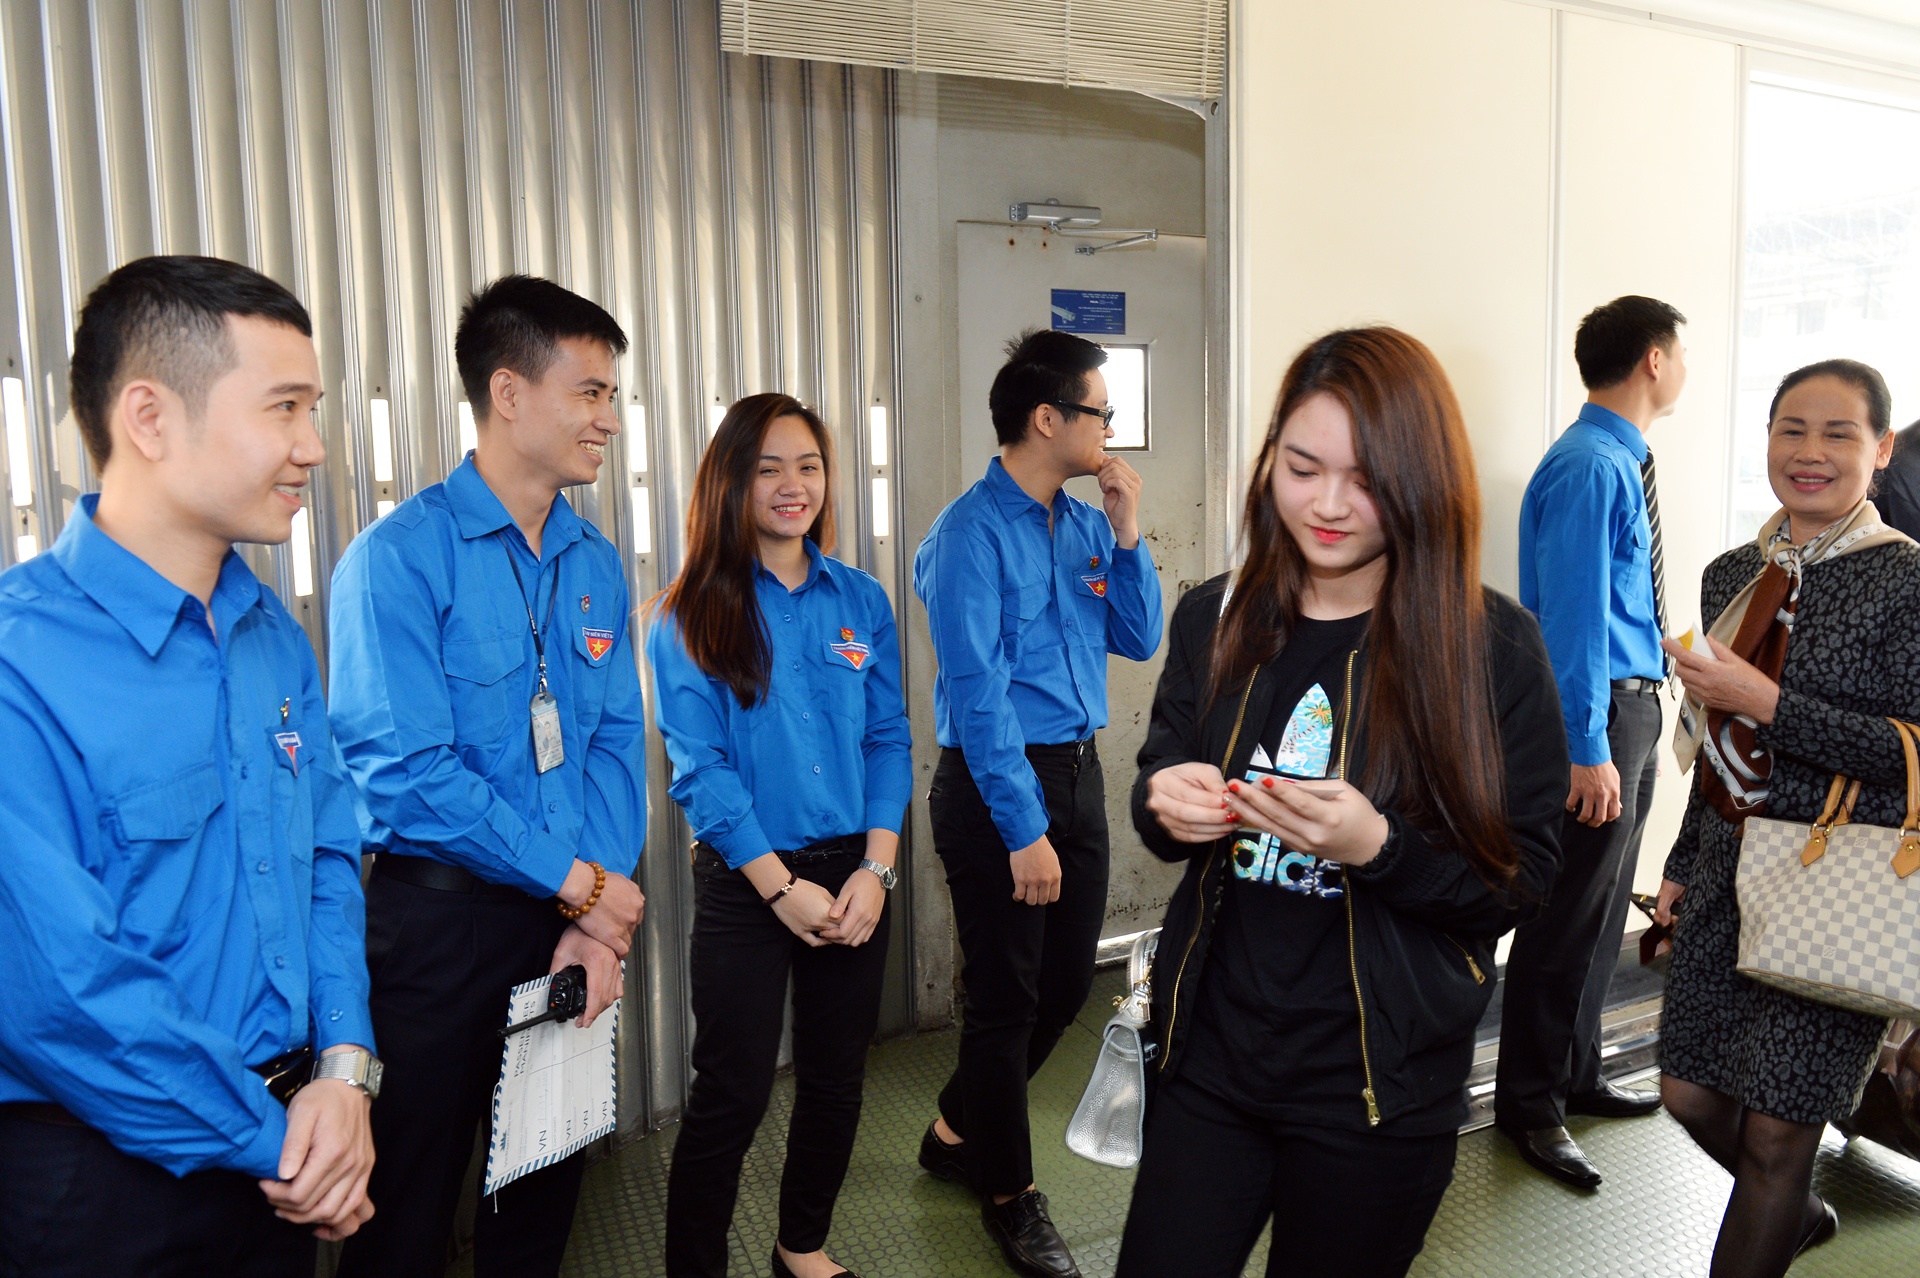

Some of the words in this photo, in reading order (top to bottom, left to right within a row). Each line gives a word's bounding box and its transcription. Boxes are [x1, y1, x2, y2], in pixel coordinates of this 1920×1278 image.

[514, 1001, 529, 1077] PASSENER
[520, 1001, 535, 1075] MANIFTS
[583, 1110, 588, 1130] VN
[602, 1101, 607, 1120] VN
[539, 1130, 547, 1152] VN
[566, 1120, 571, 1141] VN
